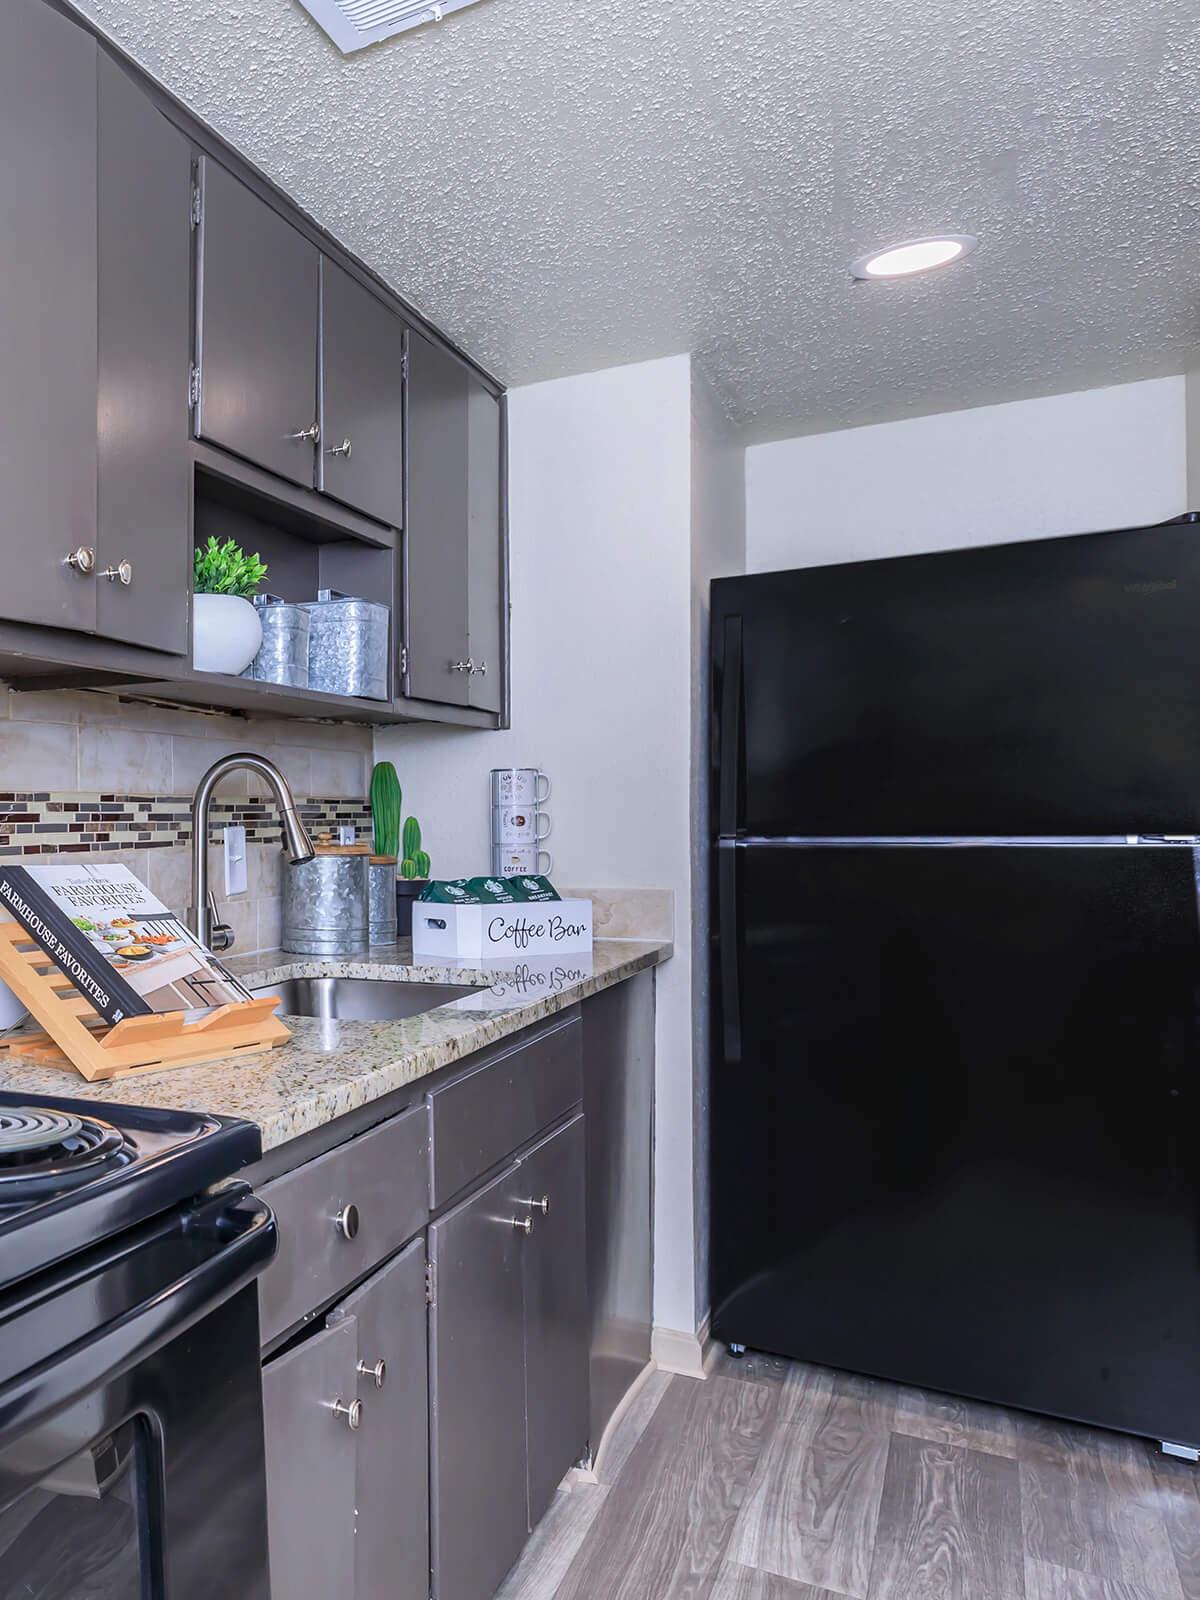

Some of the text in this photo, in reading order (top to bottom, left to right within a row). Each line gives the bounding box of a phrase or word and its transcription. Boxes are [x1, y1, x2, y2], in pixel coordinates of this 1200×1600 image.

[51, 882, 143, 896] FARMHOUSE
[67, 894, 146, 907] FAVORITES
[488, 915, 587, 948] Coffee Bar
[54, 942, 110, 1008] FAVORITES
